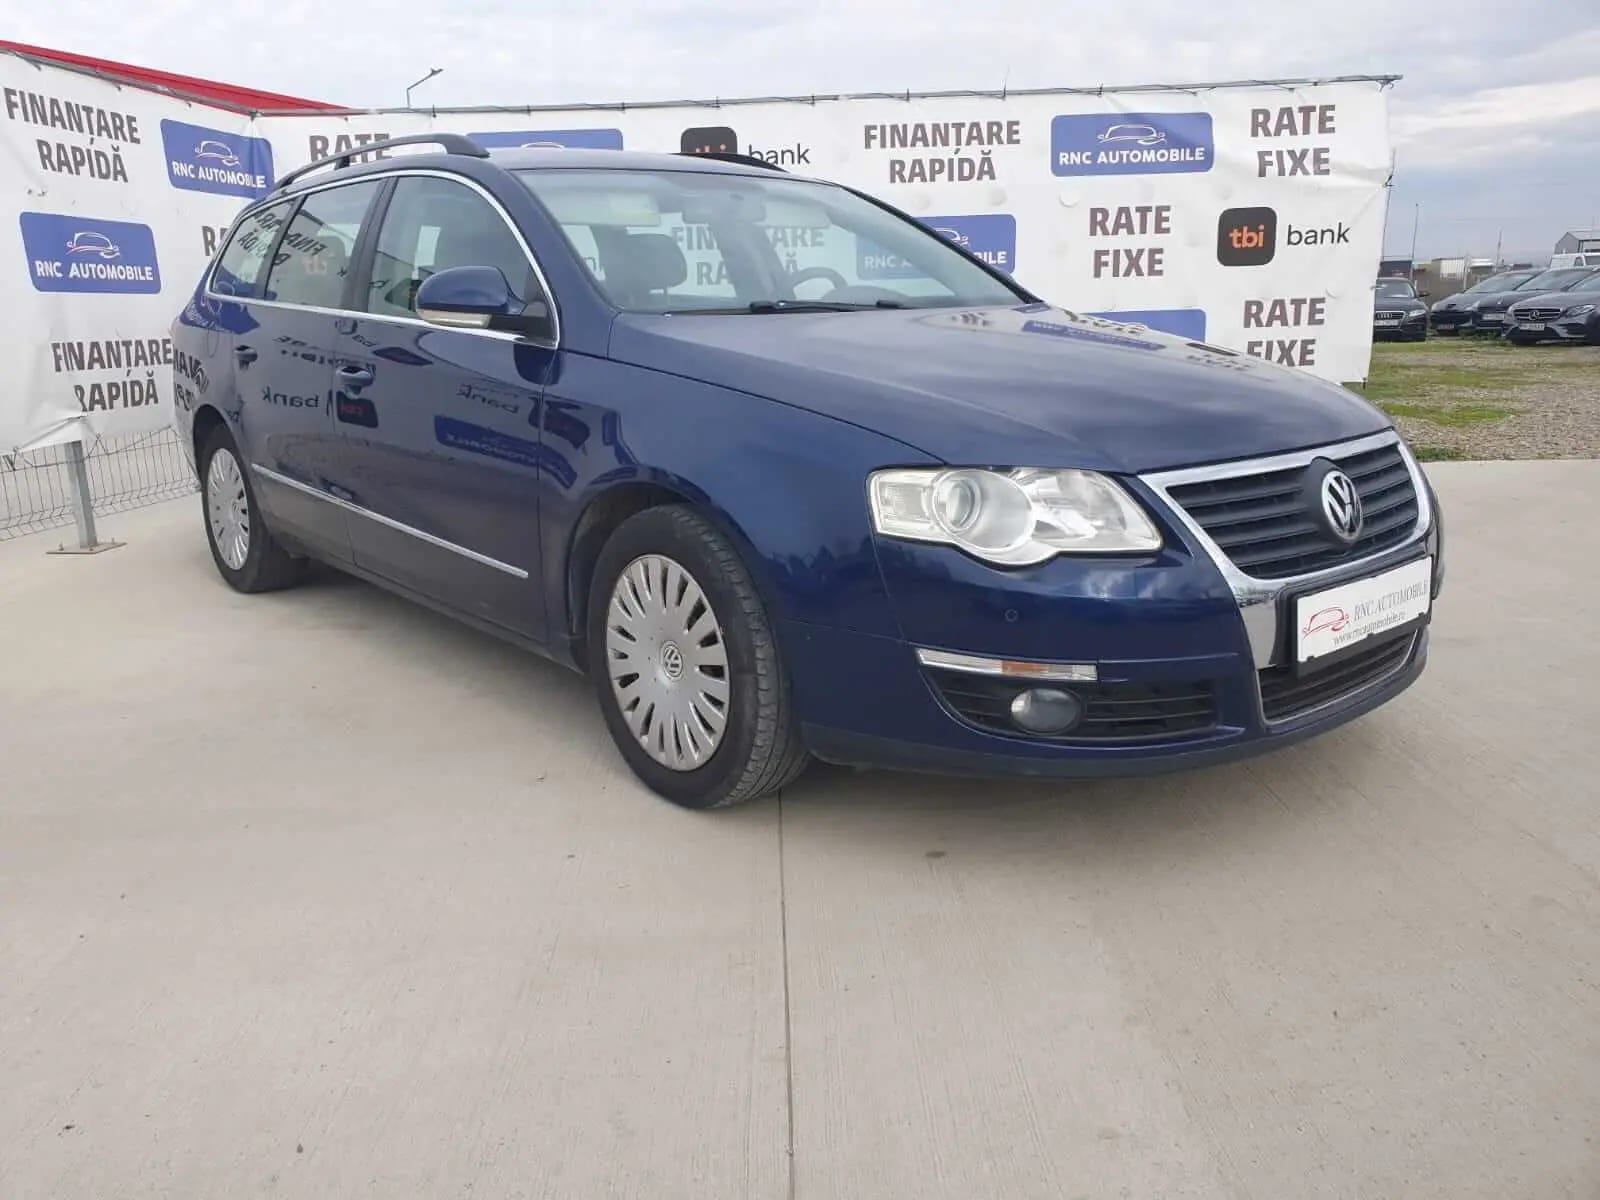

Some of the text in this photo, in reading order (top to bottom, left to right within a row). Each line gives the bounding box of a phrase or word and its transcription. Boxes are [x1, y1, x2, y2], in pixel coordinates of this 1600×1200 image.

[4, 88, 141, 145] FINANȚARE
[1250, 104, 1336, 137] RATE
[864, 120, 1021, 155] FINANȚARE
[36, 139, 128, 183] RAPIDĂ
[172, 160, 195, 178] RNC
[889, 149, 996, 184] RAPIDĂ
[1059, 147, 1205, 165] RNC AUTOMOBILE
[1257, 147, 1330, 178] FIXE
[1089, 205, 1171, 237] RATE
[1229, 221, 1350, 249] tbi bank
[34, 260, 154, 280] RNC AUTOMOBILE
[864, 255, 897, 269] RNC
[1093, 248, 1164, 279] FIXE
[1243, 297, 1326, 328] RATE
